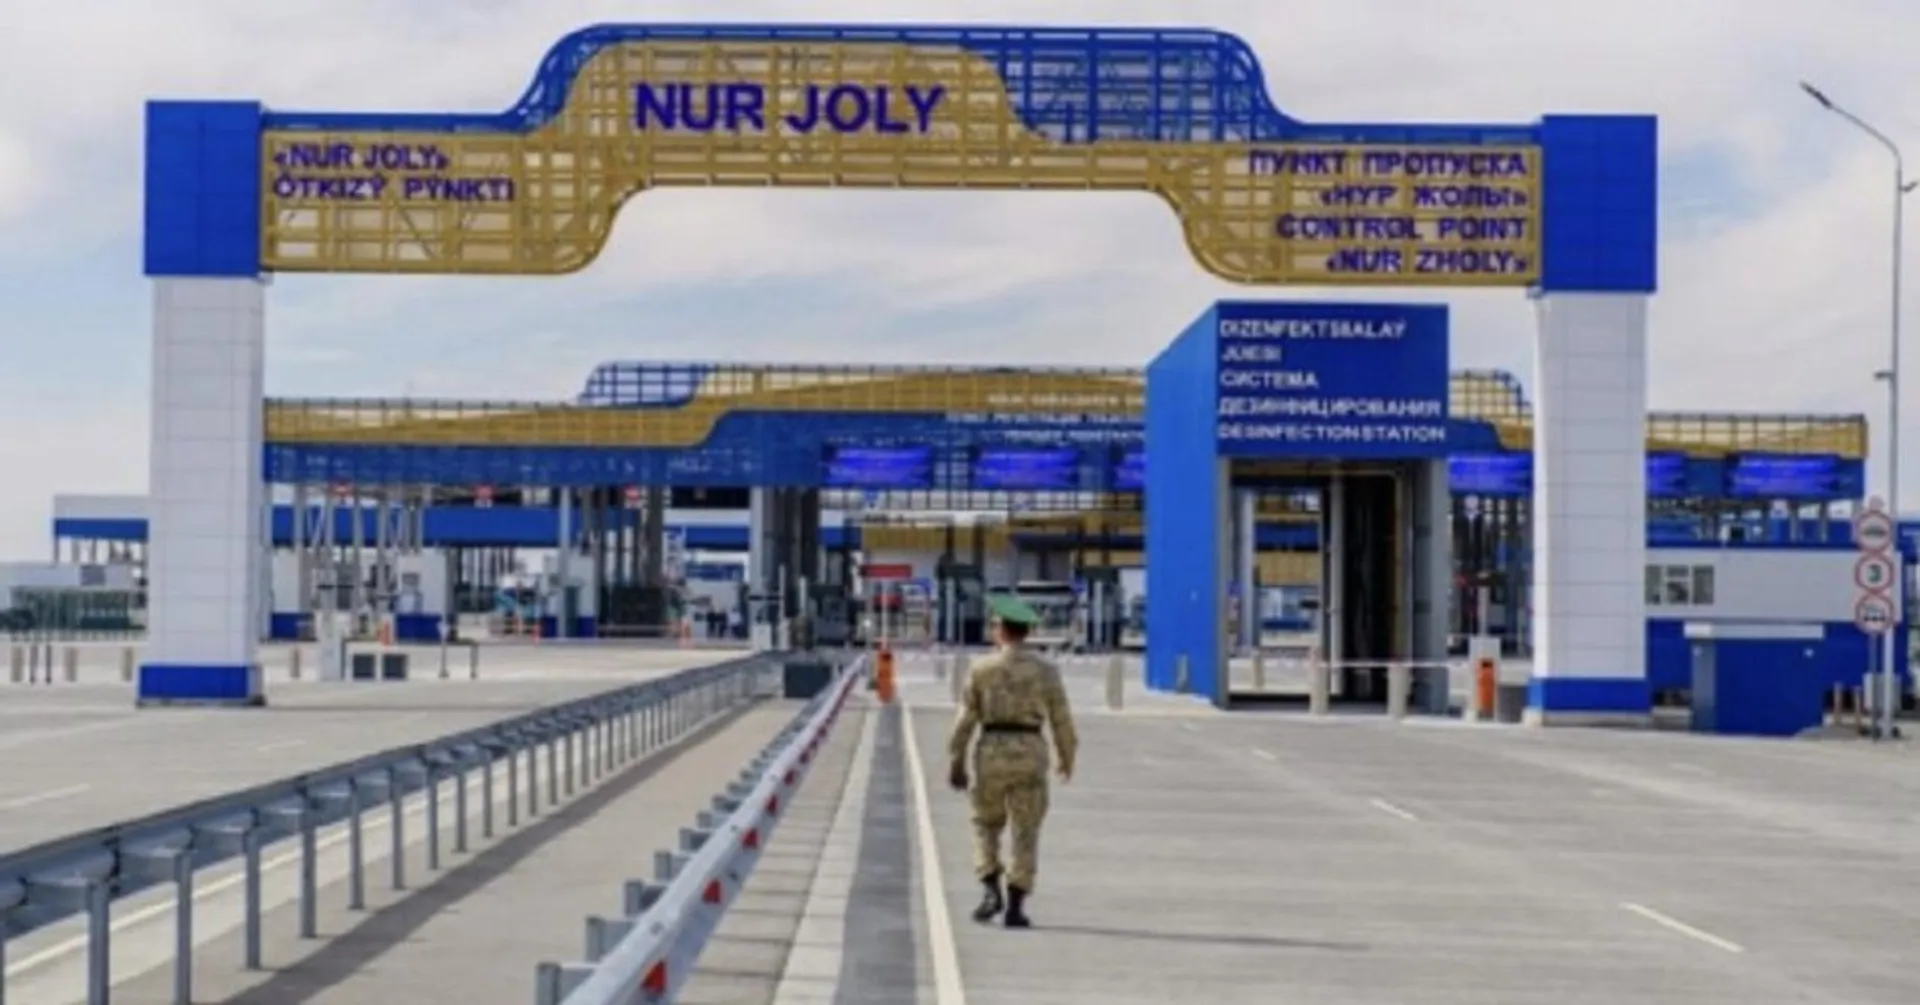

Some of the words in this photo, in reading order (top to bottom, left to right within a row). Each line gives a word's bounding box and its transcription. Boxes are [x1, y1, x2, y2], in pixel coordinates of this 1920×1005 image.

[634, 83, 766, 132] NUR
[784, 84, 946, 134] JOLY
[1249, 151, 1346, 175] ПУНКТ
[1363, 152, 1527, 176] ПРОПУСКА
[1276, 213, 1422, 239] CONTROL
[1438, 216, 1526, 239] POINT
[1219, 370, 1319, 389] СИСТЕМА
[1362, 425, 1447, 442] STATION
